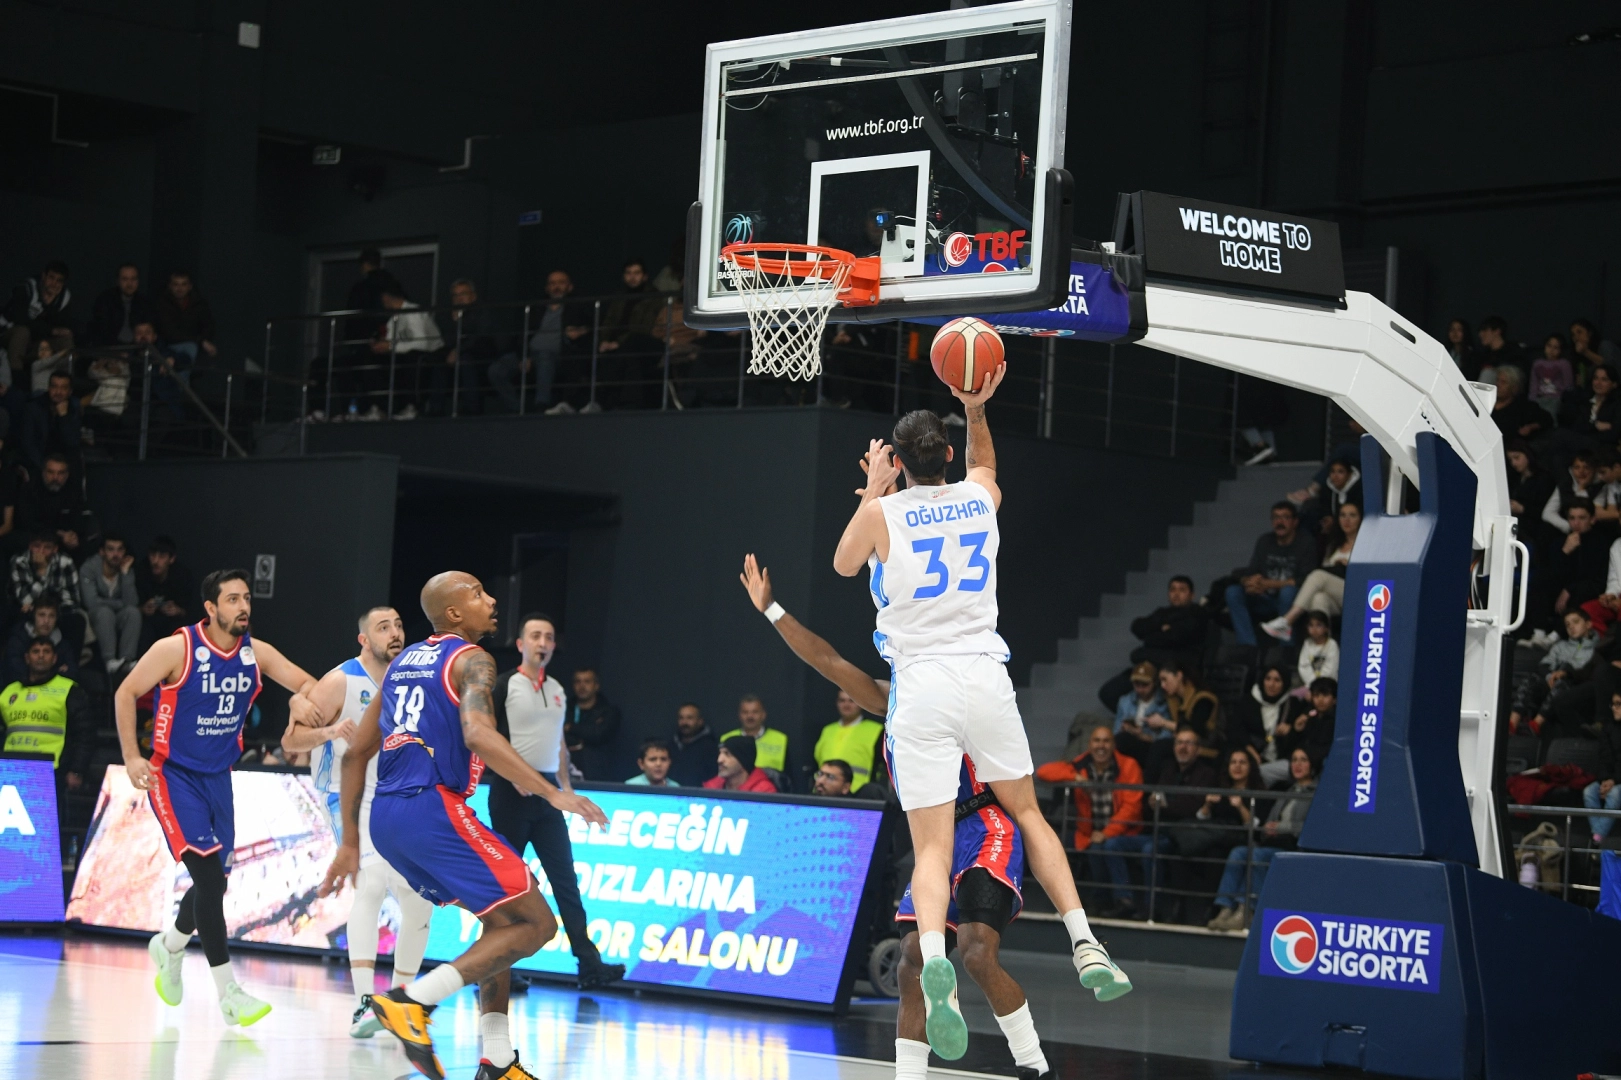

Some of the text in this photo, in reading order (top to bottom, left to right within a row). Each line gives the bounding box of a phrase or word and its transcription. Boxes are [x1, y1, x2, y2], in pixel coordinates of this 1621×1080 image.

[826, 115, 925, 141] www.tbf.org.tr
[973, 230, 1026, 262] TBF
[1178, 206, 1311, 251] WELCOME TO
[1219, 239, 1282, 274] HOME
[911, 531, 990, 599] 33
[398, 650, 441, 667] ATKINS
[202, 672, 252, 694] iLab
[155, 703, 172, 745] cimri
[216, 694, 235, 715] 13
[1354, 612, 1386, 808] TÜRKİYE SİGORTA
[454, 803, 504, 861] needek.com
[562, 803, 749, 856] ELECEĞİN
[522, 857, 757, 914] IDIZLARINA
[638, 923, 799, 976] SALONU
[1321, 920, 1431, 956] TÜRKİYE
[1317, 948, 1429, 985] SİGORTA
